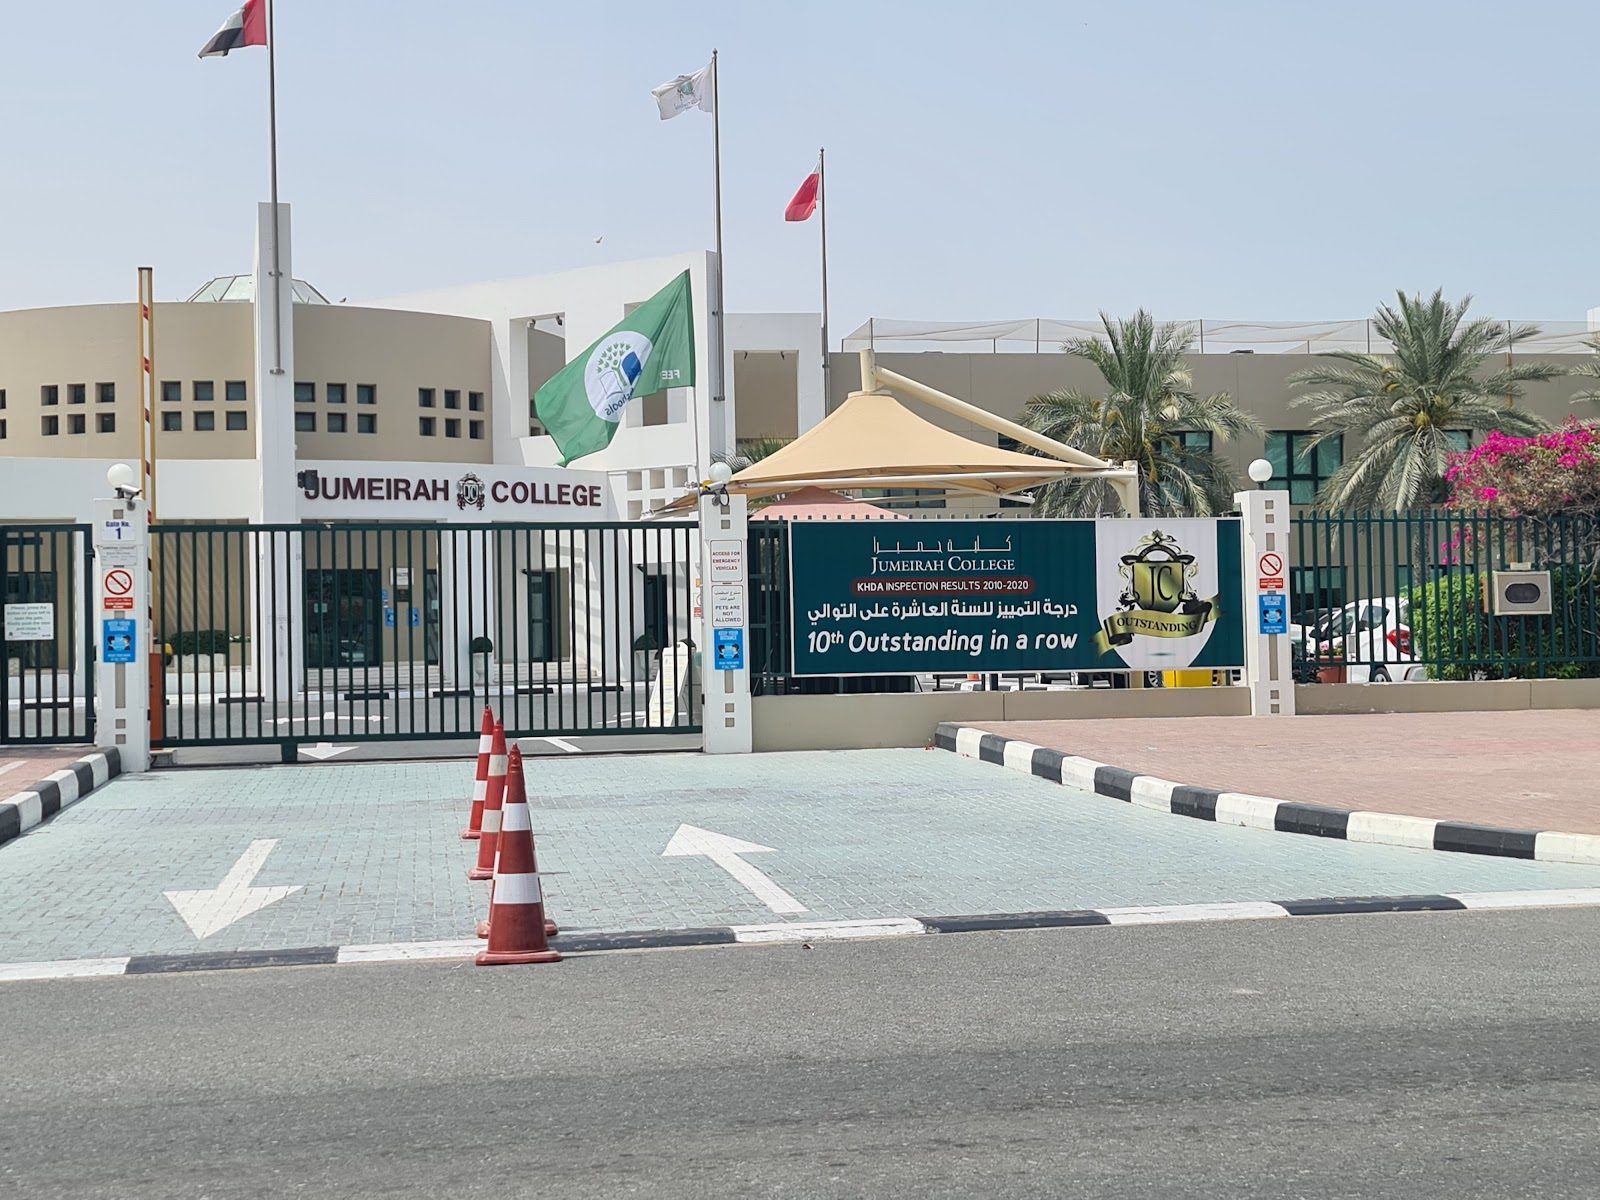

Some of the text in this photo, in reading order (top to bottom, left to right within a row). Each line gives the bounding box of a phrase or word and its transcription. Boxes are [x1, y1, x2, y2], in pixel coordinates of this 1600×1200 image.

[304, 477, 602, 507] JUMEIRAH COLLEGE
[115, 527, 121, 540] 1
[856, 580, 1029, 592] KHDA INSPECTION RESULTS 2010-2020
[1148, 565, 1173, 609] JC
[807, 598, 1078, 626] درجة التمييز للسنة العاشرة على التوالي
[1116, 616, 1198, 633] OUTSTANDING
[807, 629, 1079, 657] 10th Outstanding in a row
